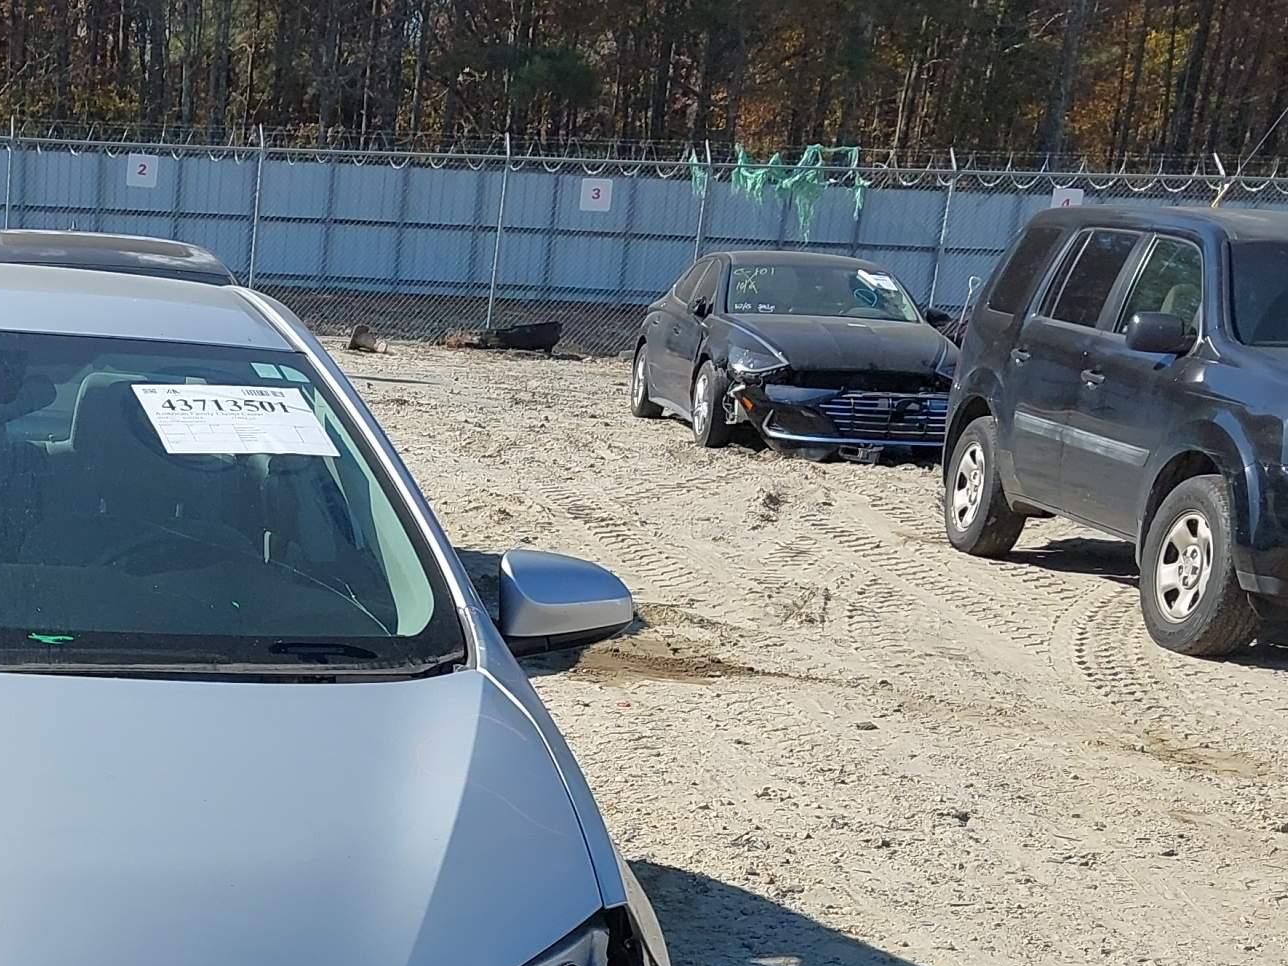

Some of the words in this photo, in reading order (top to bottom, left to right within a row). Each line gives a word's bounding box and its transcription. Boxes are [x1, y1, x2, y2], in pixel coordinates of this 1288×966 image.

[137, 163, 147, 176] 2
[591, 188, 601, 200] 3
[161, 398, 290, 414] 43713501
